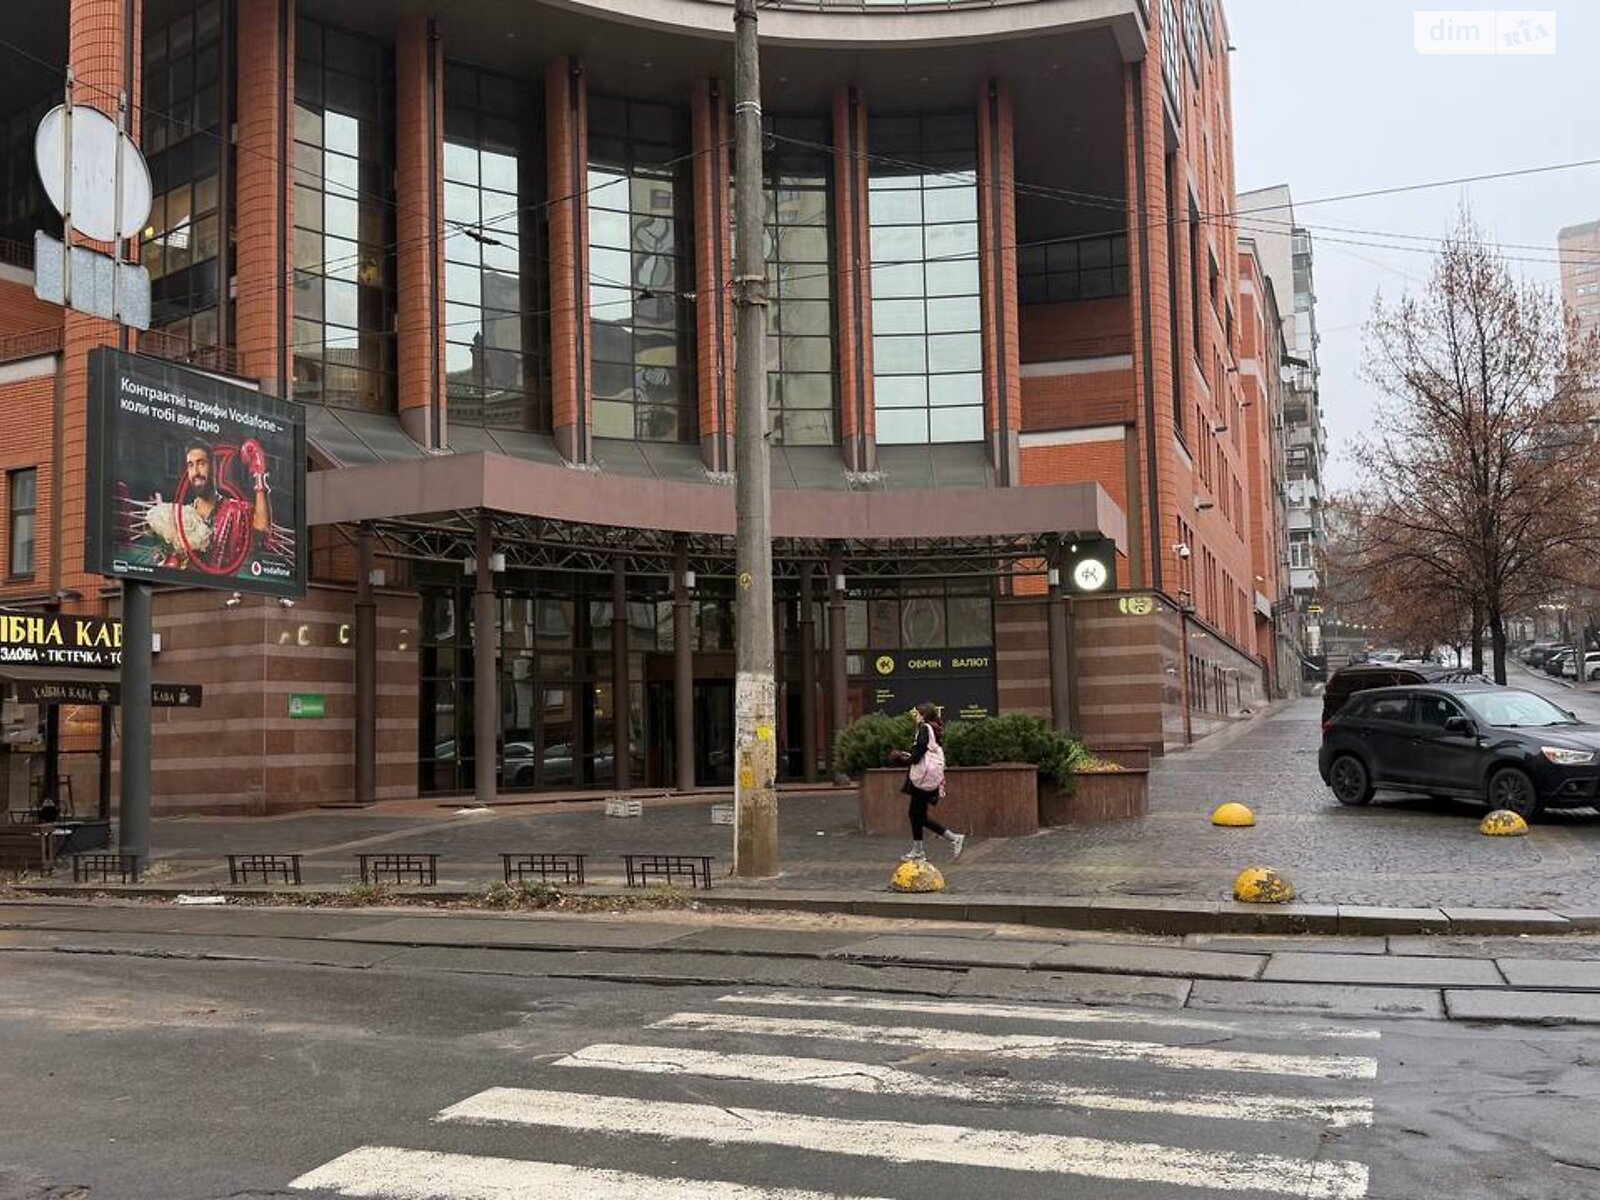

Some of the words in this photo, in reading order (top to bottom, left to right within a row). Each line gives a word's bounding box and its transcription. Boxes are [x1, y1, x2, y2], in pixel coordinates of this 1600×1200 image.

[121, 376, 187, 407] Контрактні
[187, 398, 228, 419] тарифи
[228, 407, 277, 432] Vodafone
[120, 398, 150, 416] коли
[150, 406, 176, 422] тобі
[176, 413, 220, 433] вигідно
[263, 566, 290, 577] vodafone
[47, 649, 102, 662] ТІСТЕЧКА
[908, 658, 942, 670] ОБМІН
[951, 656, 990, 668] ВАЛЮТ
